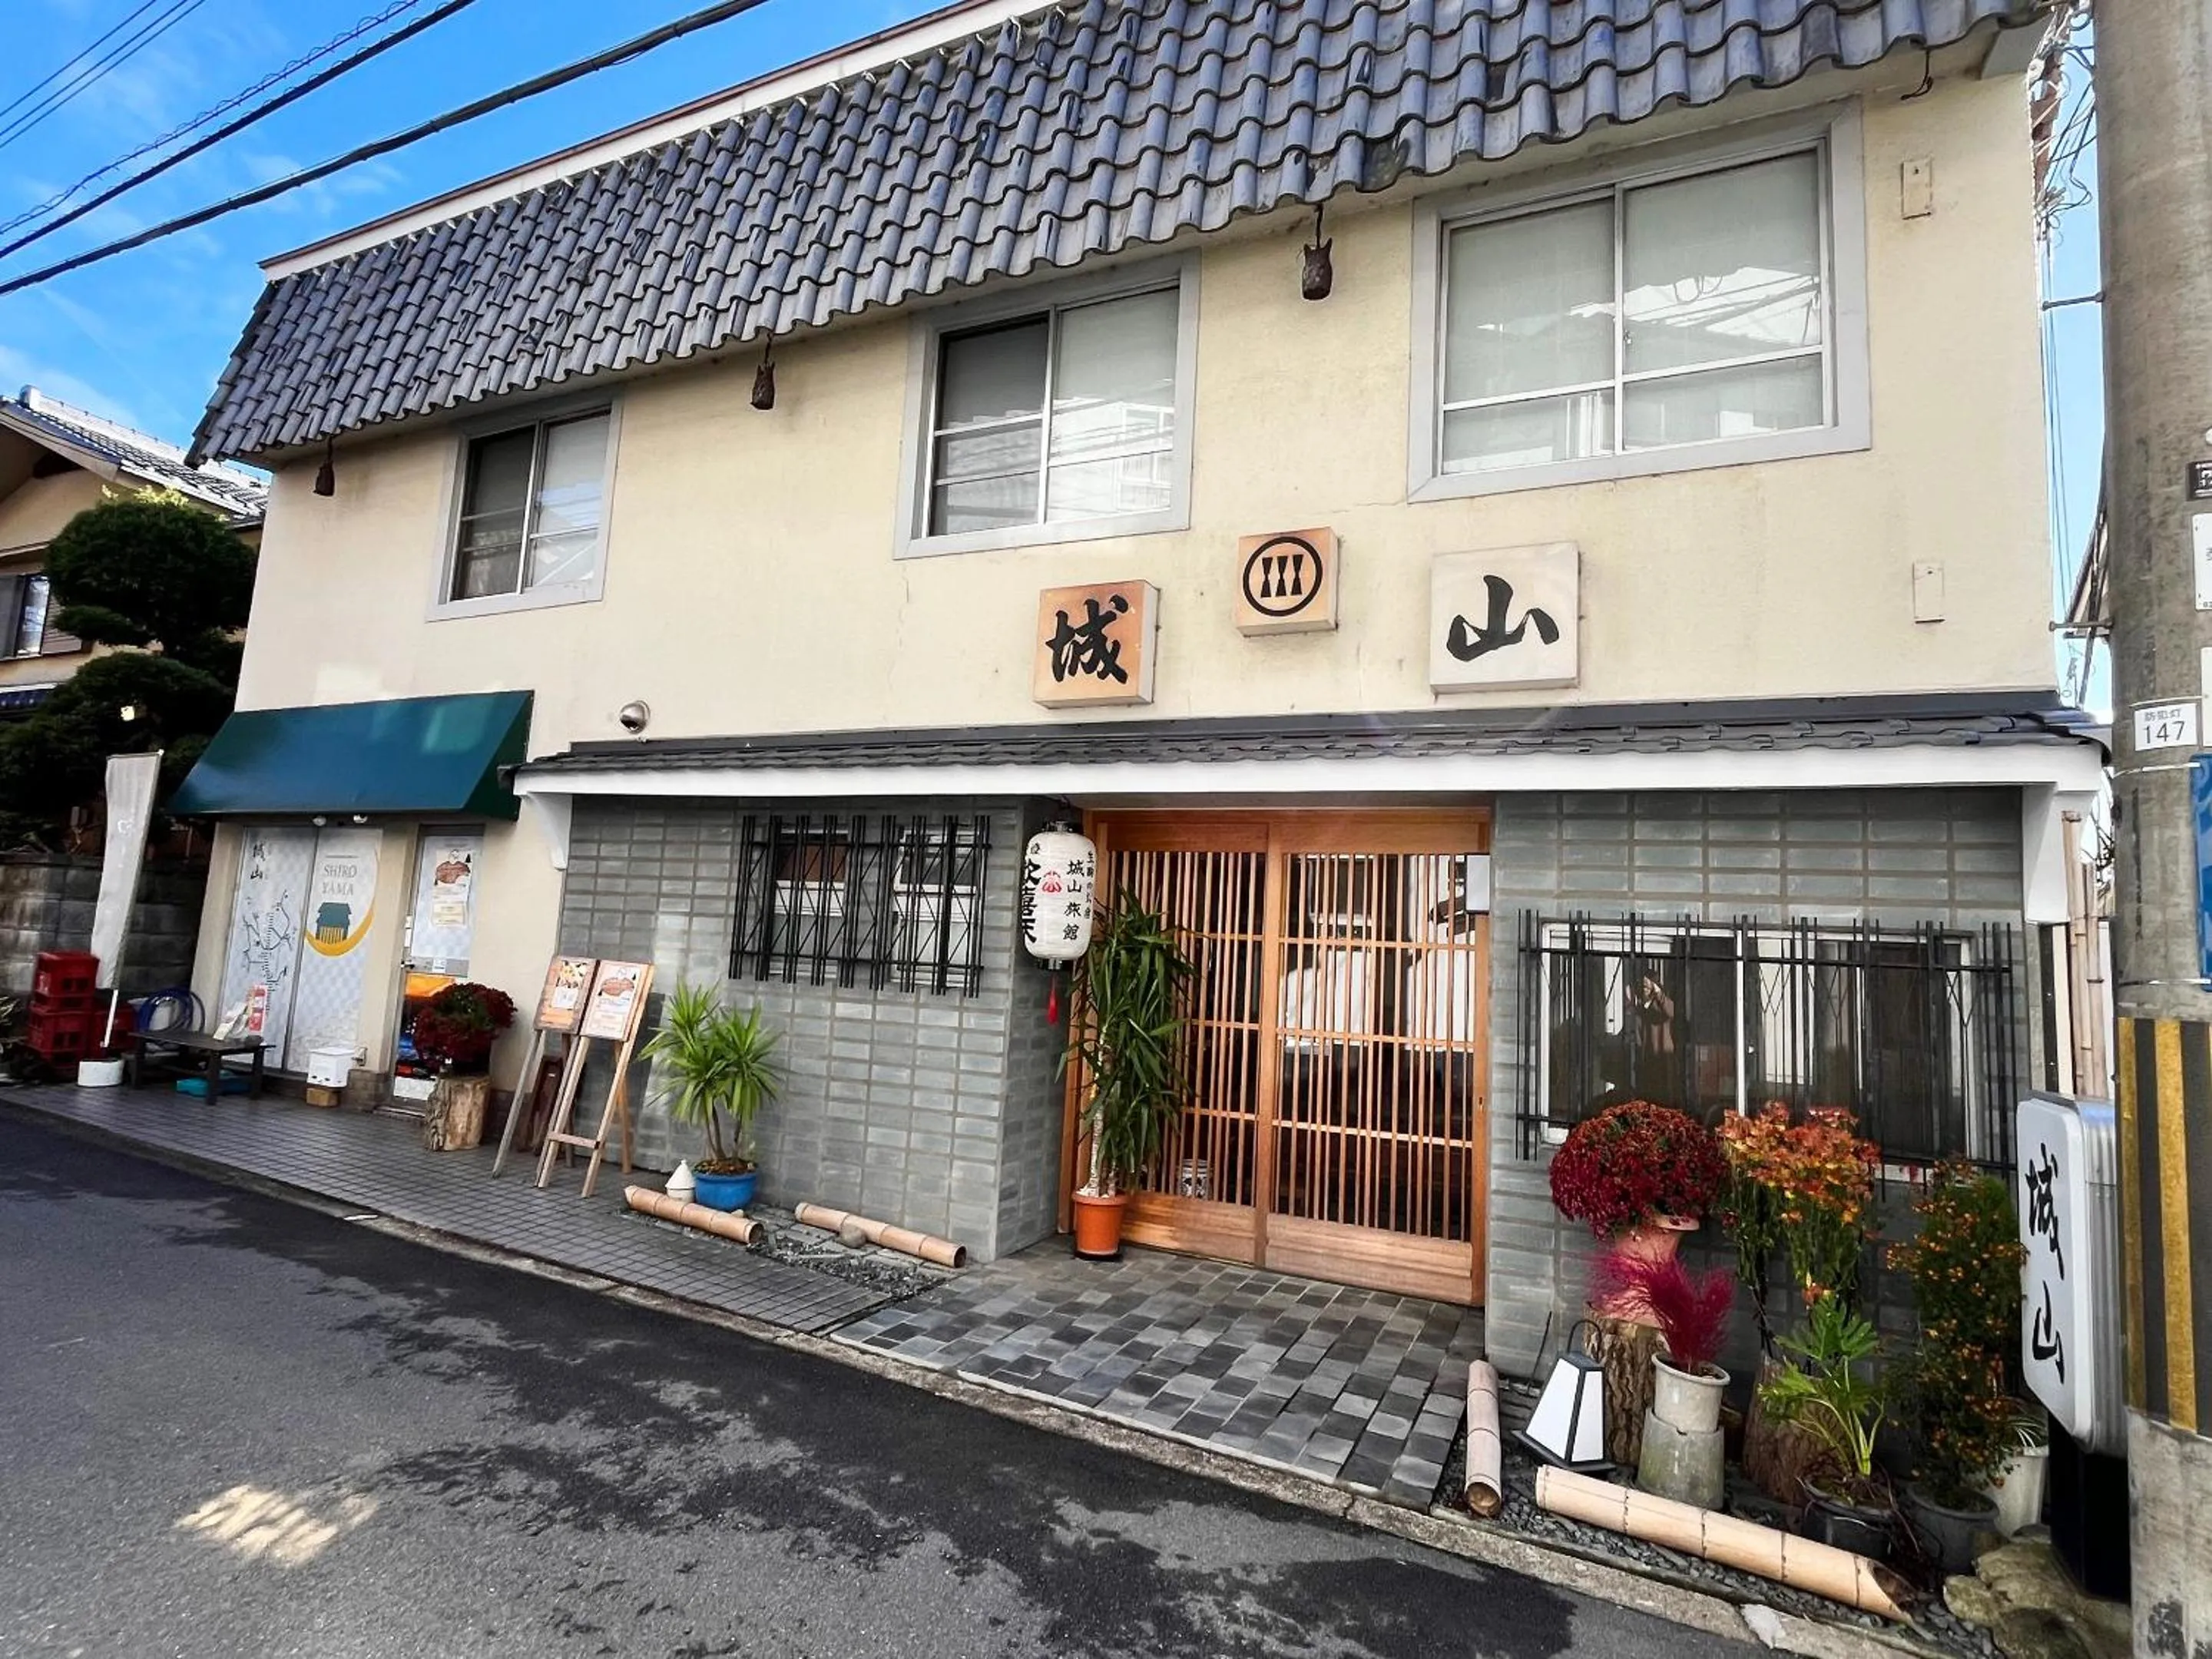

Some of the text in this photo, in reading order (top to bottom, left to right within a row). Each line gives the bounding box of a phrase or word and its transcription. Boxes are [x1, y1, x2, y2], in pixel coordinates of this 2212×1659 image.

[1045, 593, 1129, 685] 城
[1445, 574, 1560, 663] 山
[2143, 720, 2186, 743] 147
[322, 881, 354, 896] YAMA
[323, 864, 358, 878] SHIRO
[1062, 859, 1085, 941] 城山旅館
[2025, 1142, 2065, 1385] 城山
